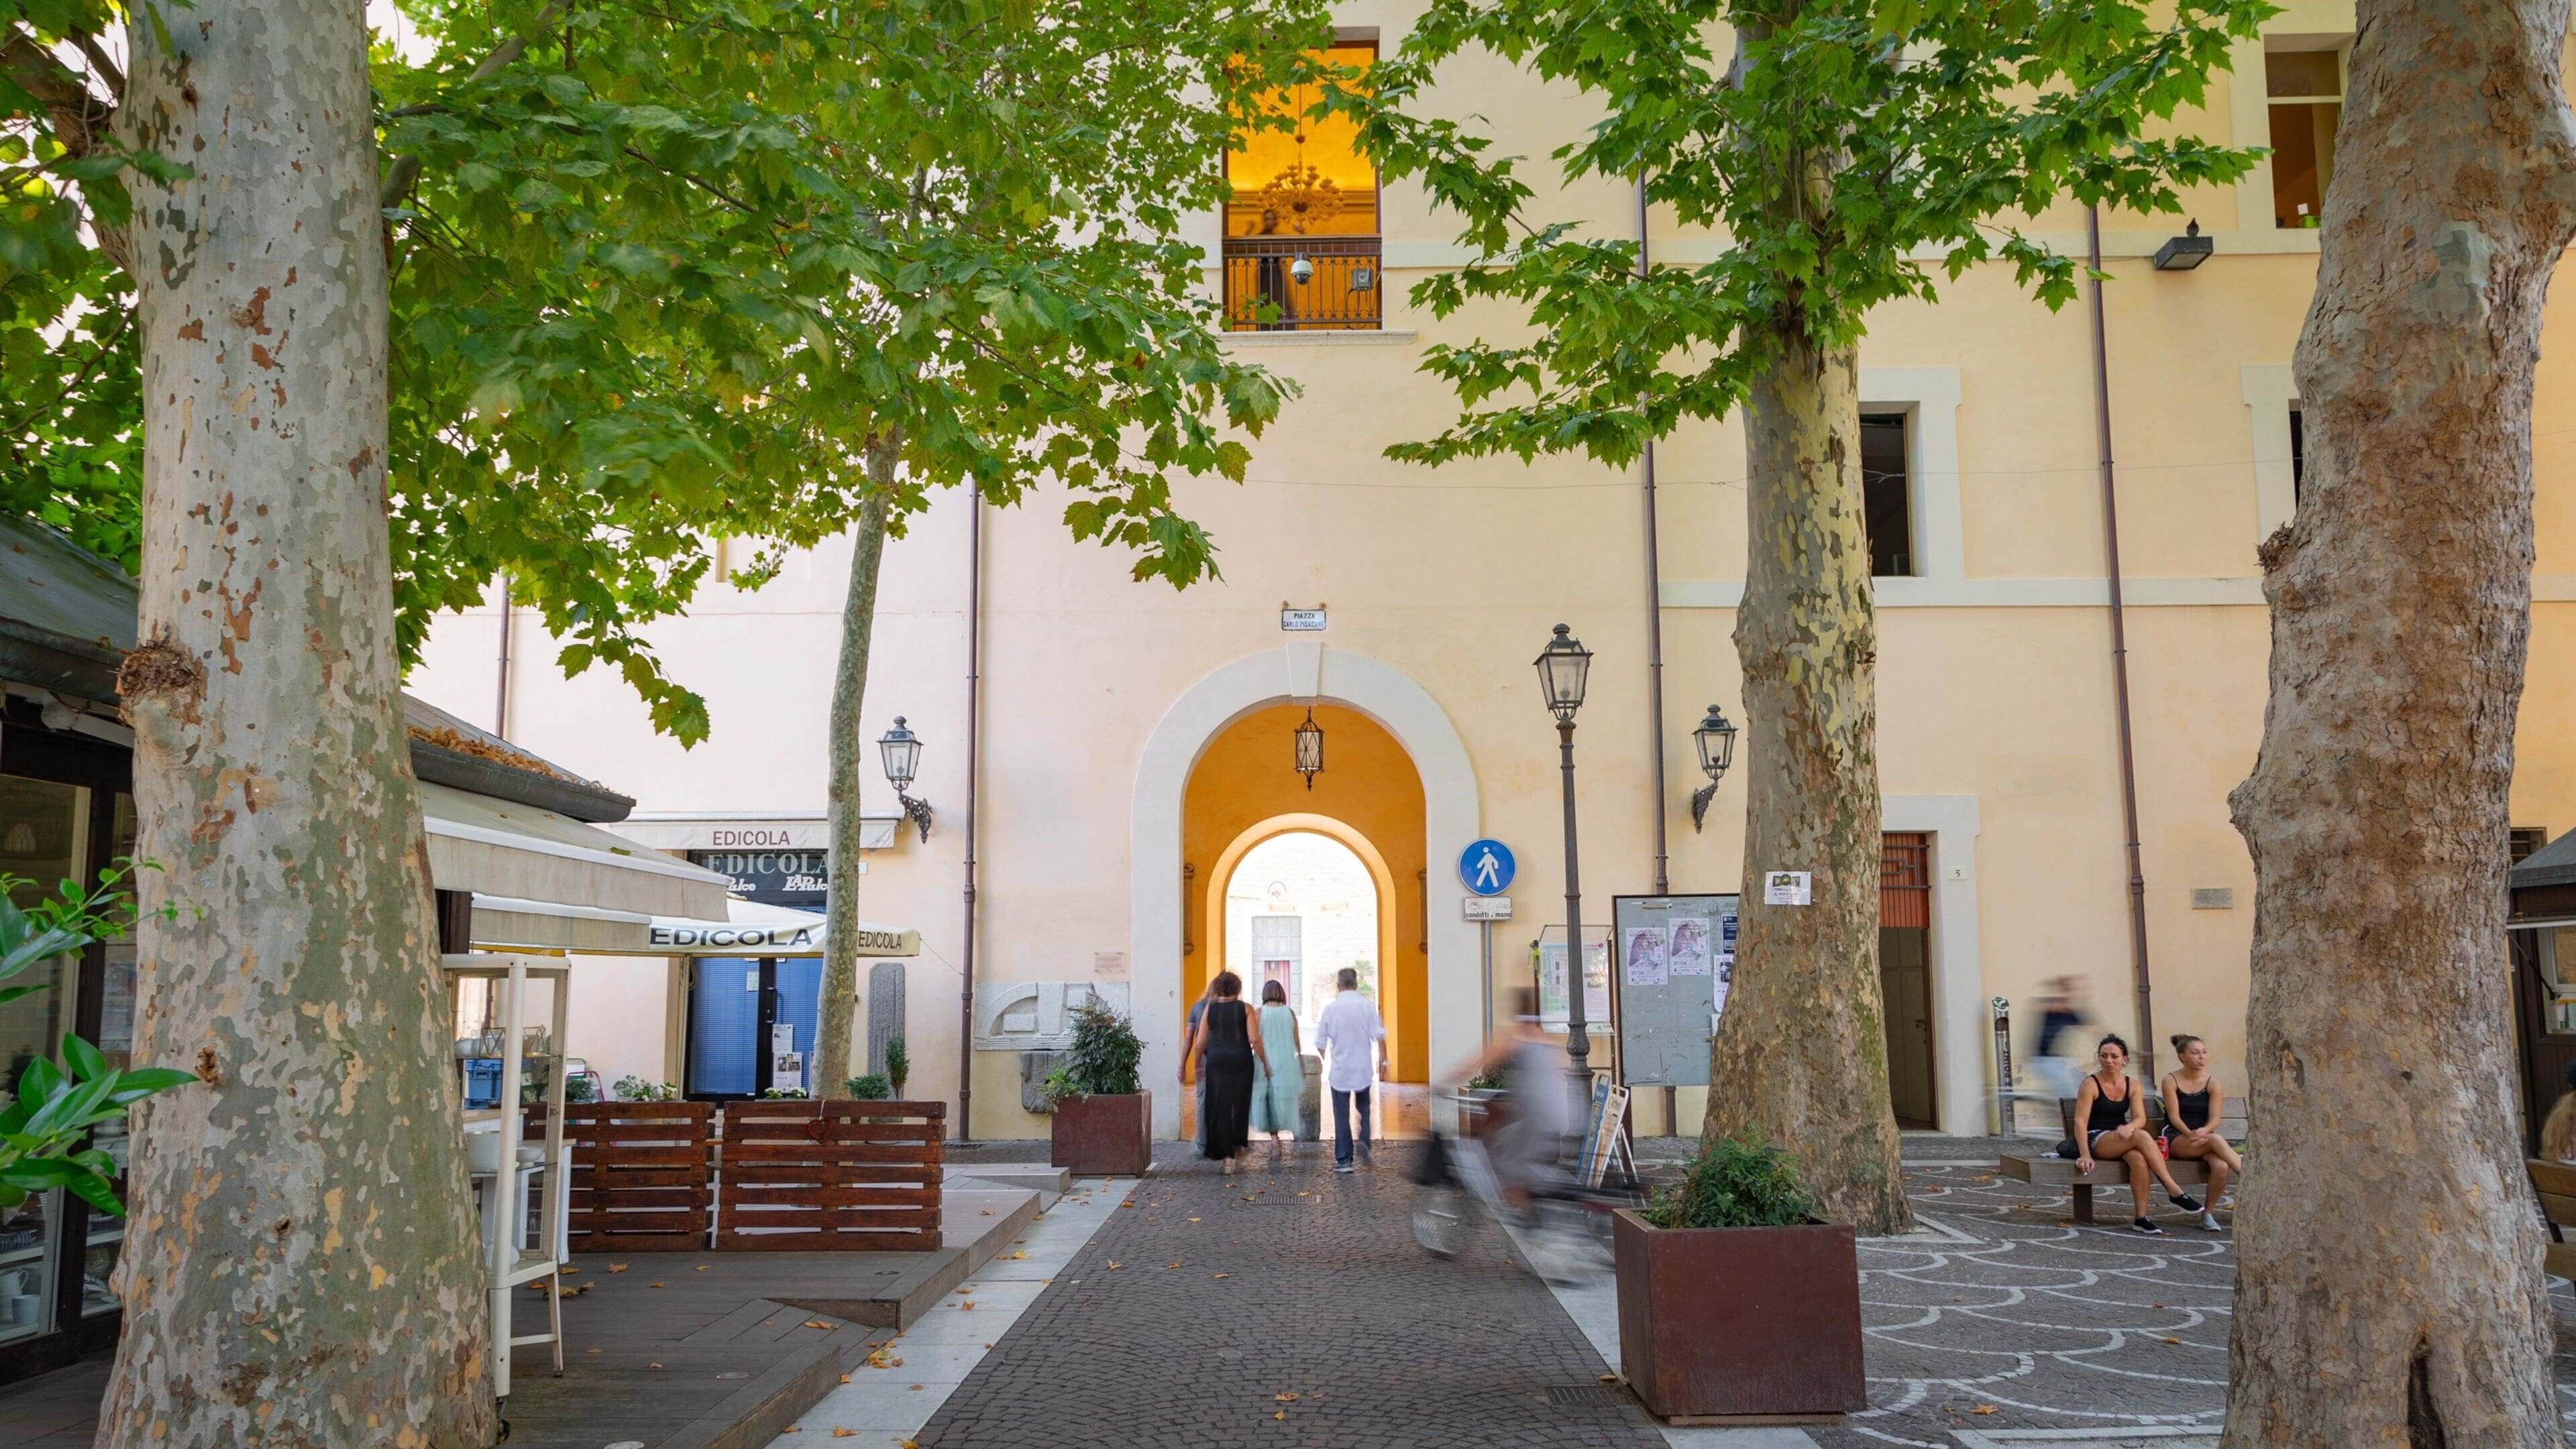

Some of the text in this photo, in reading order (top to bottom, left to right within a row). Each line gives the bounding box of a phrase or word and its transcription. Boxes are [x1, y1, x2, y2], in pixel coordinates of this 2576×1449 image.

[712, 830, 790, 846] EDICOLA
[707, 853, 828, 875] EDICOLA
[1955, 869, 1960, 877] 5
[649, 927, 813, 947] EDICOLA
[858, 930, 902, 949] EDICOLA
[2003, 1050, 2011, 1078] POINT
